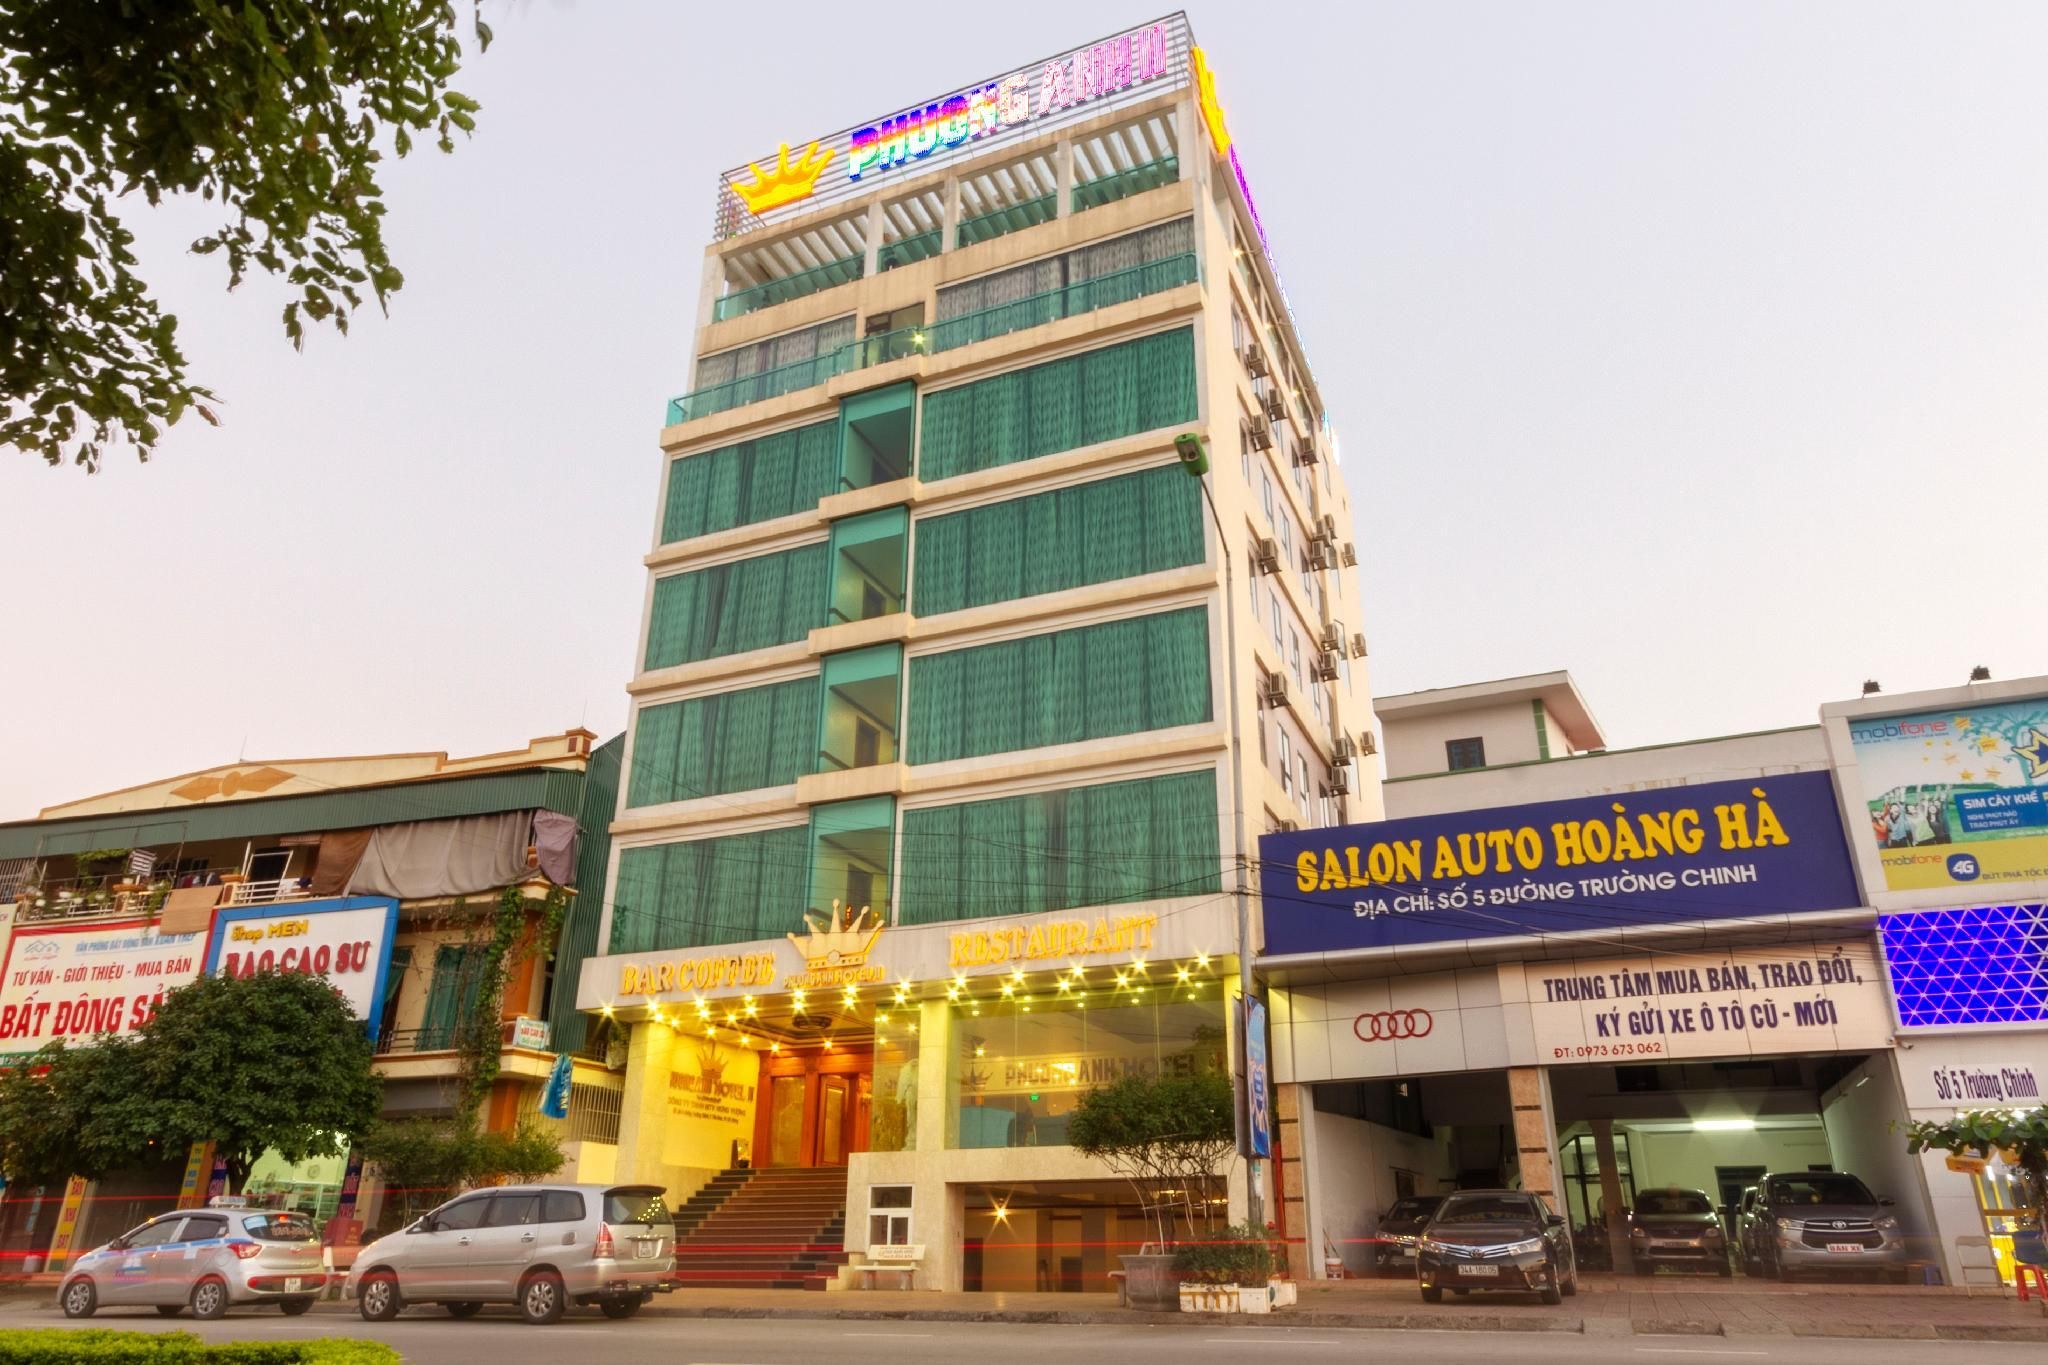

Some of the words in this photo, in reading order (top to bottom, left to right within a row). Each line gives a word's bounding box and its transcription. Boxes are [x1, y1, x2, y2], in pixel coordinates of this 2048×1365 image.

[1037, 35, 1132, 117] ANH
[1851, 720, 1948, 741] mobifone
[1963, 798, 1986, 809] SIM
[1296, 840, 1422, 892] SALON
[1432, 827, 1543, 879] AUTO
[1551, 802, 1705, 866] HOÀNG
[1713, 787, 1790, 849] HÀ
[1952, 860, 1974, 874] 4G
[1354, 899, 1390, 920] ĐỊA
[1437, 882, 1468, 910] SỐ
[1473, 889, 1486, 907] 5
[1489, 878, 1575, 905] ĐƯỜNG
[1579, 868, 1677, 897] TRƯỜNG
[1681, 864, 1758, 887] CHINH
[231, 924, 264, 944] Shop
[268, 919, 309, 939] MEN
[948, 914, 1158, 967] RESTAURANT
[13, 970, 30, 986] TƯ
[30, 965, 53, 985] VẤN
[64, 962, 87, 983] GIỚI
[91, 961, 125, 982] THIỆU
[135, 960, 162, 977] MUA
[165, 956, 192, 974] BÁN
[279, 944, 331, 976] CAO
[335, 940, 371, 973] SU
[620, 960, 674, 995] BAR
[676, 952, 777, 992] COFFEE
[1543, 975, 1607, 1002] TRUNG
[1610, 967, 1653, 998] TÂM
[1656, 968, 1703, 995] MUA
[1706, 960, 1756, 991] BÁN,
[1758, 960, 1813, 988] TRAO
[0, 990, 51, 1039] BẤT
[52, 992, 126, 1042] ĐỘNG
[128, 983, 175, 1031] SẢ
[1596, 1005, 1620, 1037] KÝ
[1628, 1001, 1665, 1036] GỬI
[1668, 1008, 1697, 1034] XE
[1700, 1002, 1714, 1031] Ô
[1718, 1000, 1745, 1030] TÔ
[1750, 998, 1778, 1029] CŨ
[1794, 993, 1838, 1027] MỚI
[1577, 1044, 1608, 1057] 0973
[1612, 1043, 1635, 1056] 673
[1637, 1042, 1662, 1054] 062
[1934, 1065, 1951, 1100] Số
[1951, 1070, 1962, 1099] 5
[1961, 1068, 2004, 1102] Trường
[2001, 1067, 2038, 1098] Chinh
